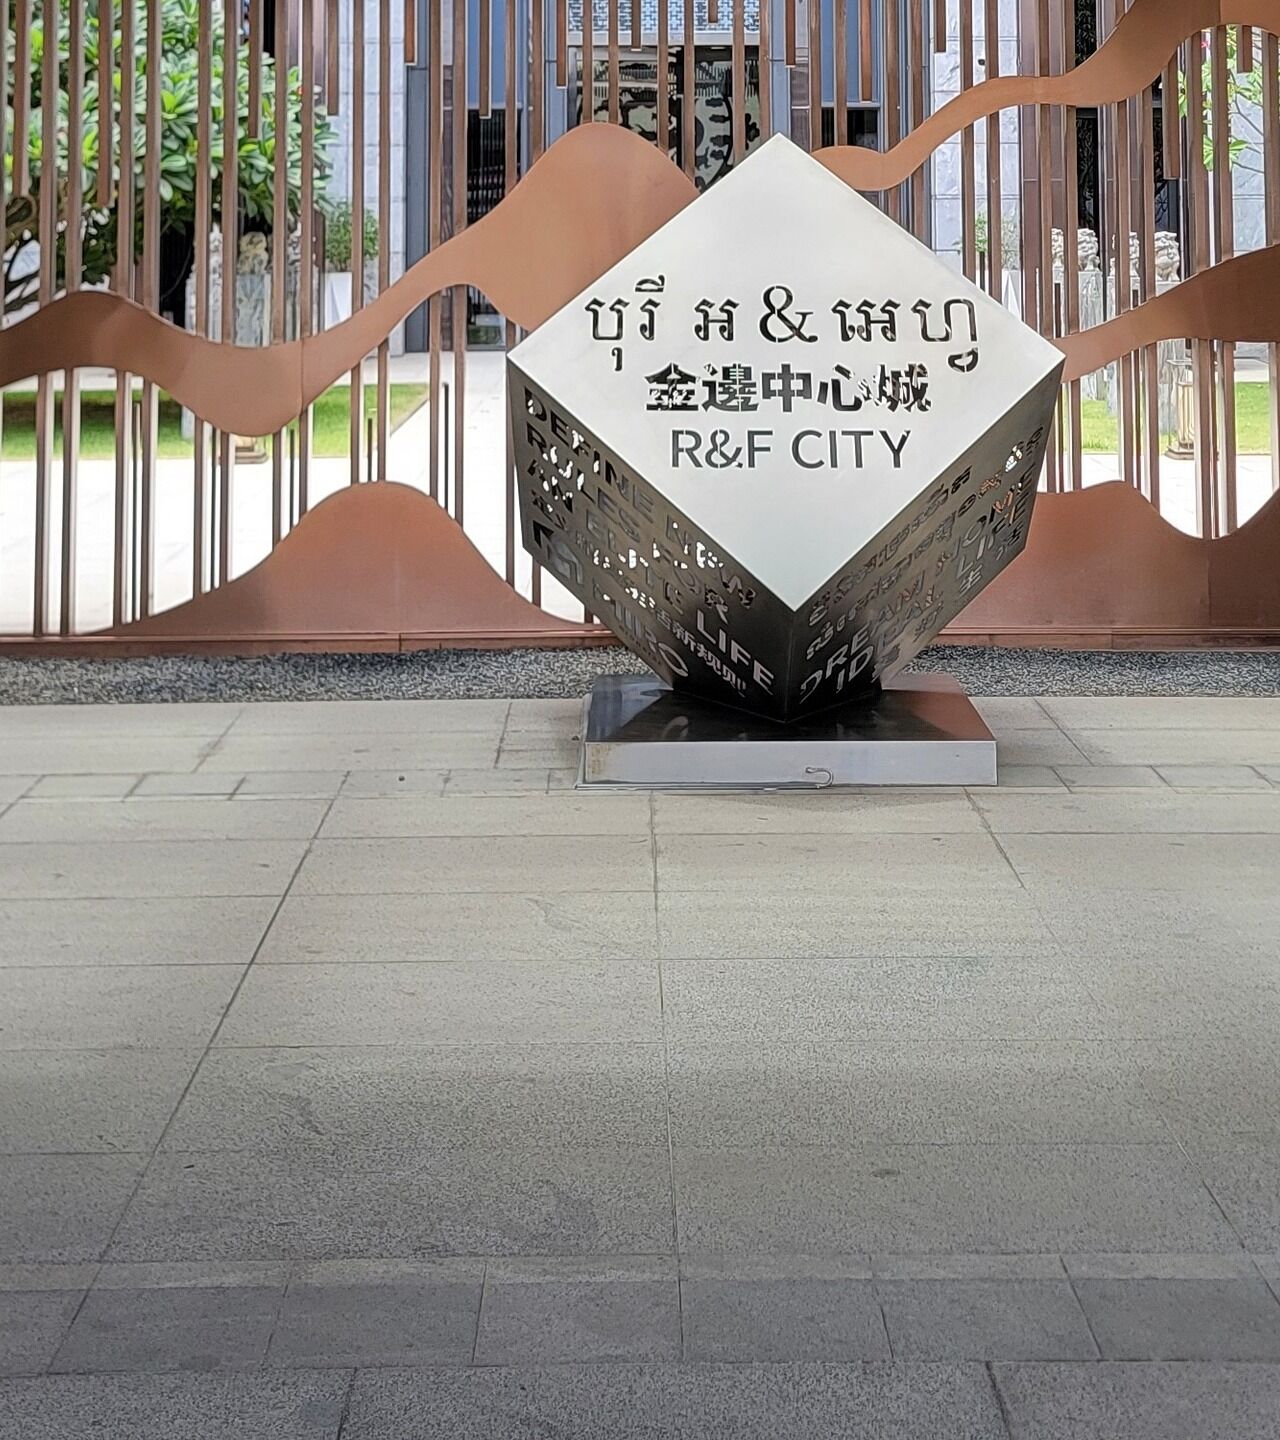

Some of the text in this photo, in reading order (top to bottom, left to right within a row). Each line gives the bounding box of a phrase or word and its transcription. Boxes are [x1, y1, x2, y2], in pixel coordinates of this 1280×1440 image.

[645, 363, 932, 413] 金邊中心城
[672, 429, 912, 469] R&F CITY
[522, 383, 654, 526] DEFINE
[666, 511, 756, 610] NEW
[525, 420, 640, 545] RULES
[652, 536, 729, 626] FOR
[798, 567, 926, 705] DREAM
[934, 459, 1037, 576] HOME
[835, 574, 946, 694] IDEAL
[954, 491, 1030, 581] LIFE
[695, 606, 775, 697] LIFE
